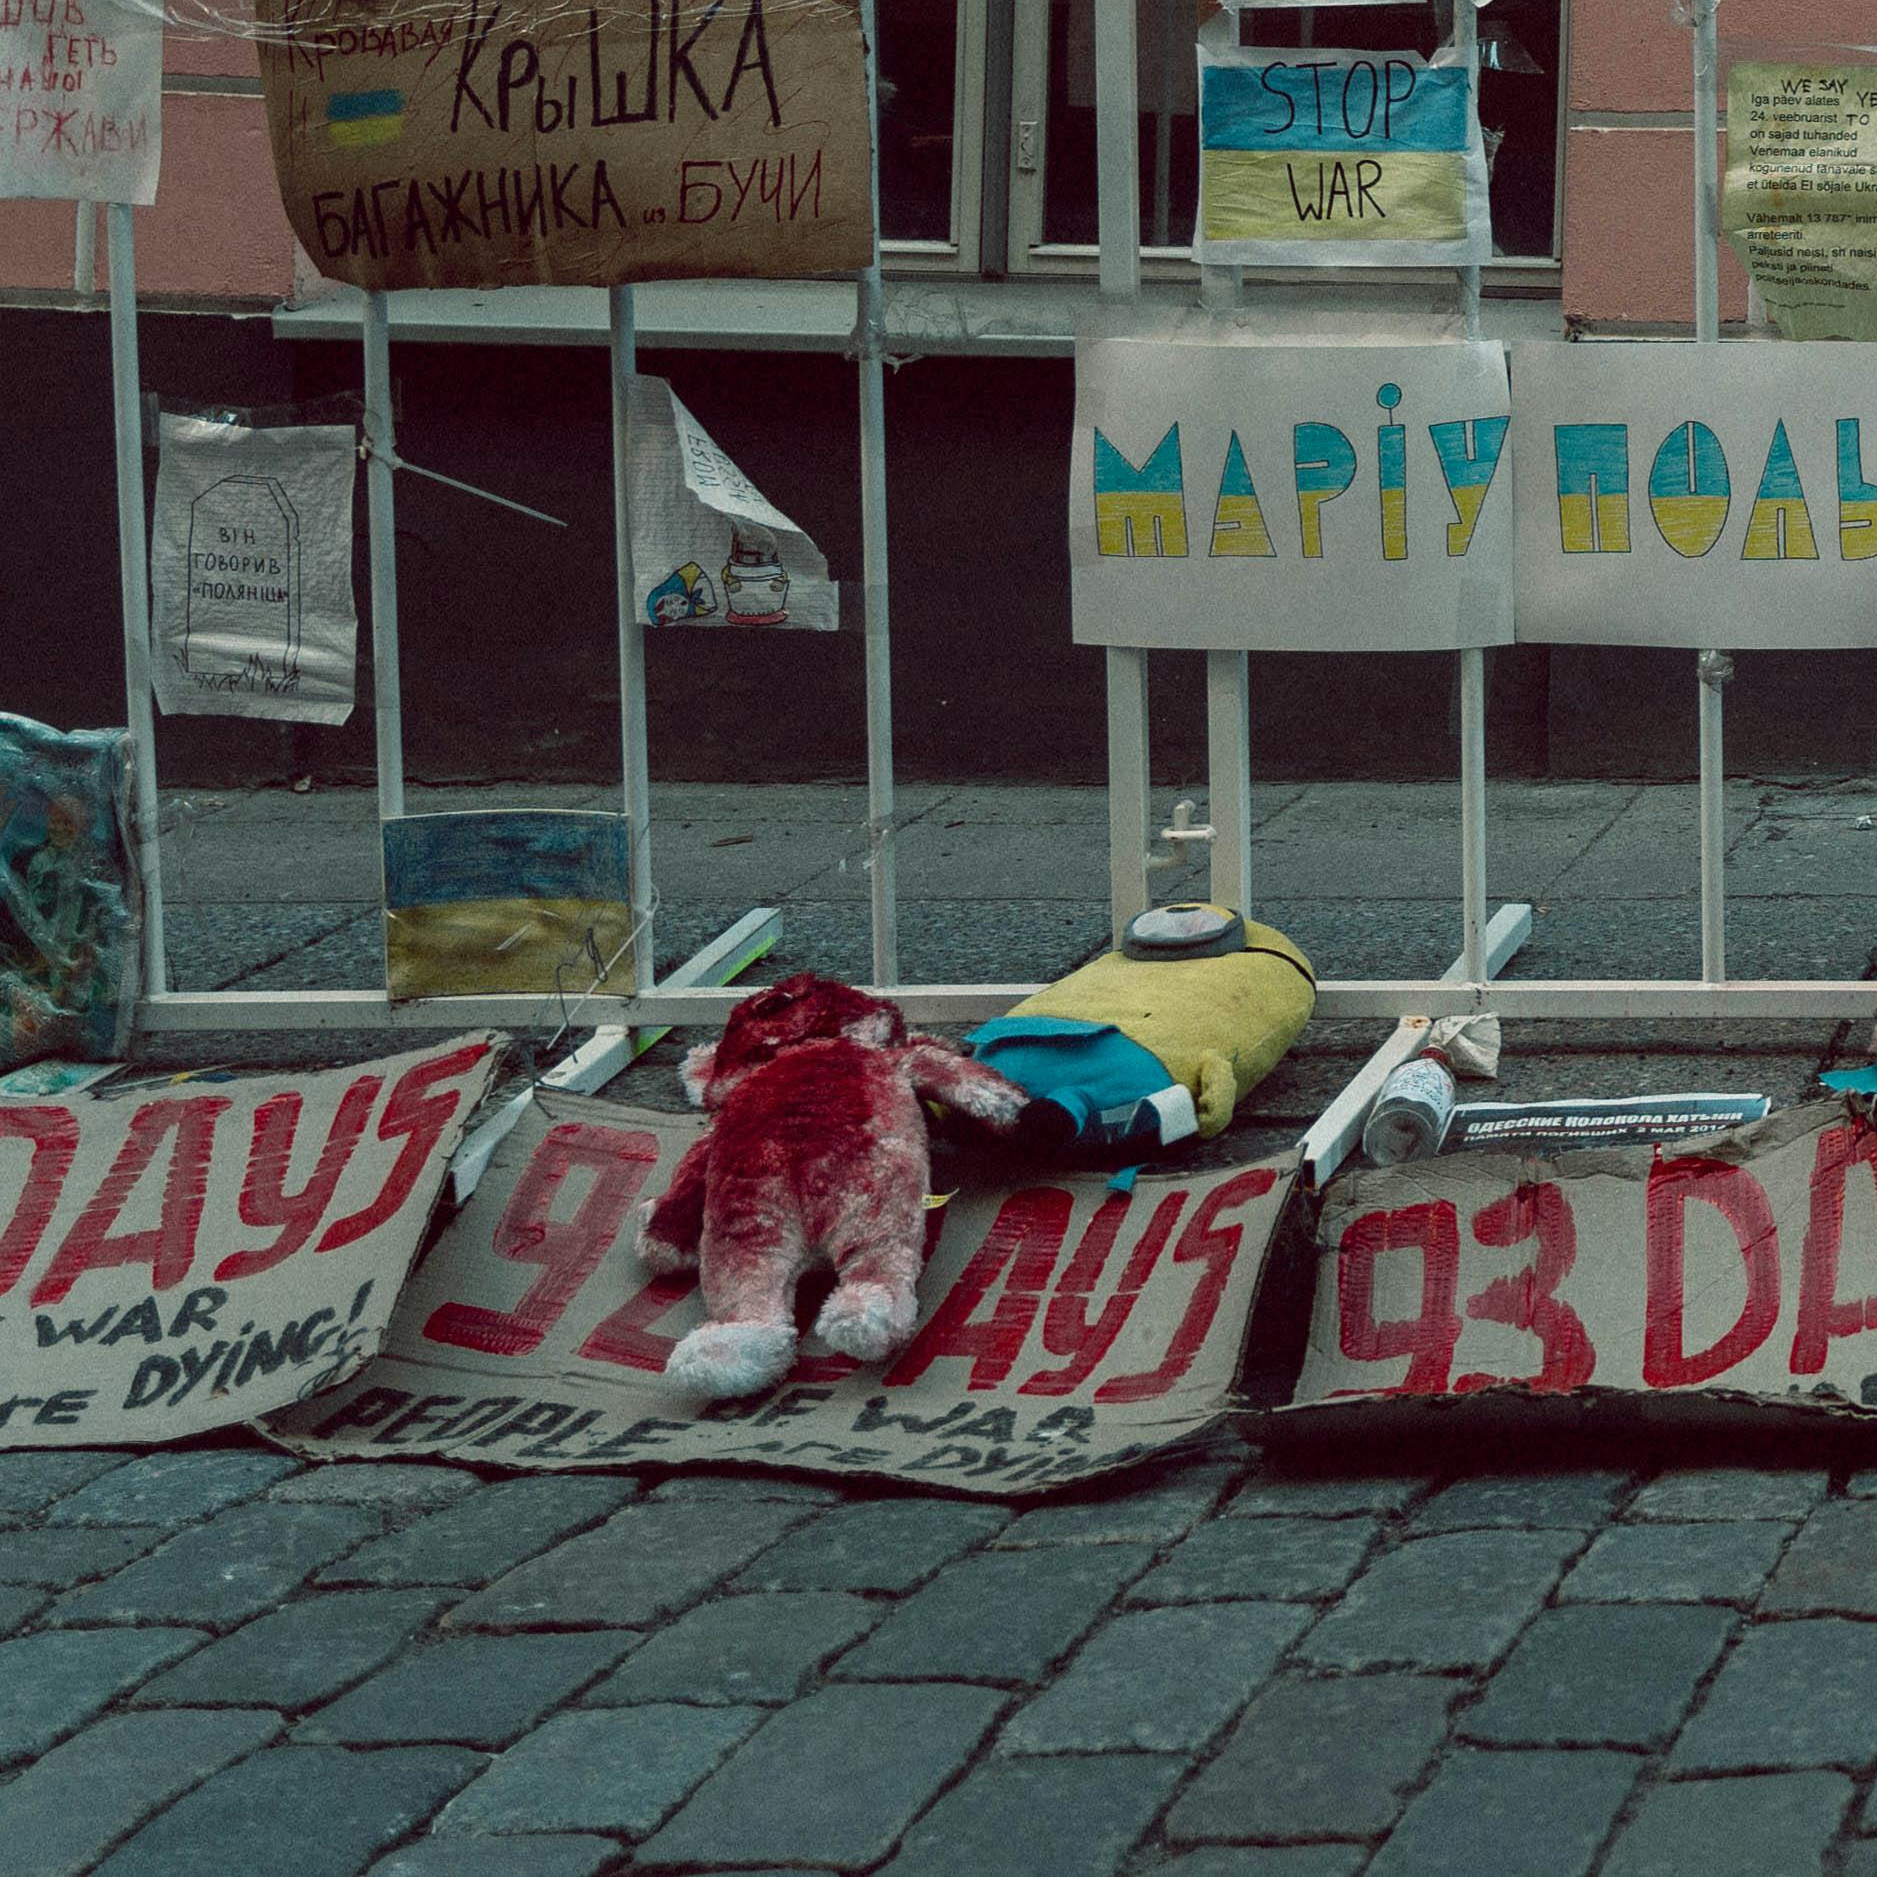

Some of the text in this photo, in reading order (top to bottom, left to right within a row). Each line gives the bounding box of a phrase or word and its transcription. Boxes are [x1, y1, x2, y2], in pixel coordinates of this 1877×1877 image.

[1781, 79, 1812, 94] WE
[1819, 78, 1848, 94] SAY
[1260, 60, 1416, 139] STOP
[1752, 94, 1840, 107] Iga päev alates
[1773, 112, 1838, 123] veebruarist
[1846, 113, 1870, 126] TO
[1750, 129, 1858, 142] on sajad tuhanded
[1750, 145, 1857, 158] Venemaa elanikud
[1286, 160, 1386, 221] WAR
[1747, 180, 1850, 193] et sõjale
[311, 148, 824, 260] БАГАЖНИКА из БУЧИ
[1747, 213, 1803, 224] Vähemalt
[1807, 213, 1821, 223] 13
[219, 527, 255, 544] ВІН
[193, 552, 281, 575] ГОВОРИВ
[1466, 1110, 1744, 1134] ОДЕССКИЕ КОЛОКОЛА ХАТЫНИ
[1330, 1180, 1597, 1397] 93
[35, 1286, 229, 1348] WAR
[314, 1389, 692, 1460] PEOPLE
[850, 1395, 1095, 1444] WAR
